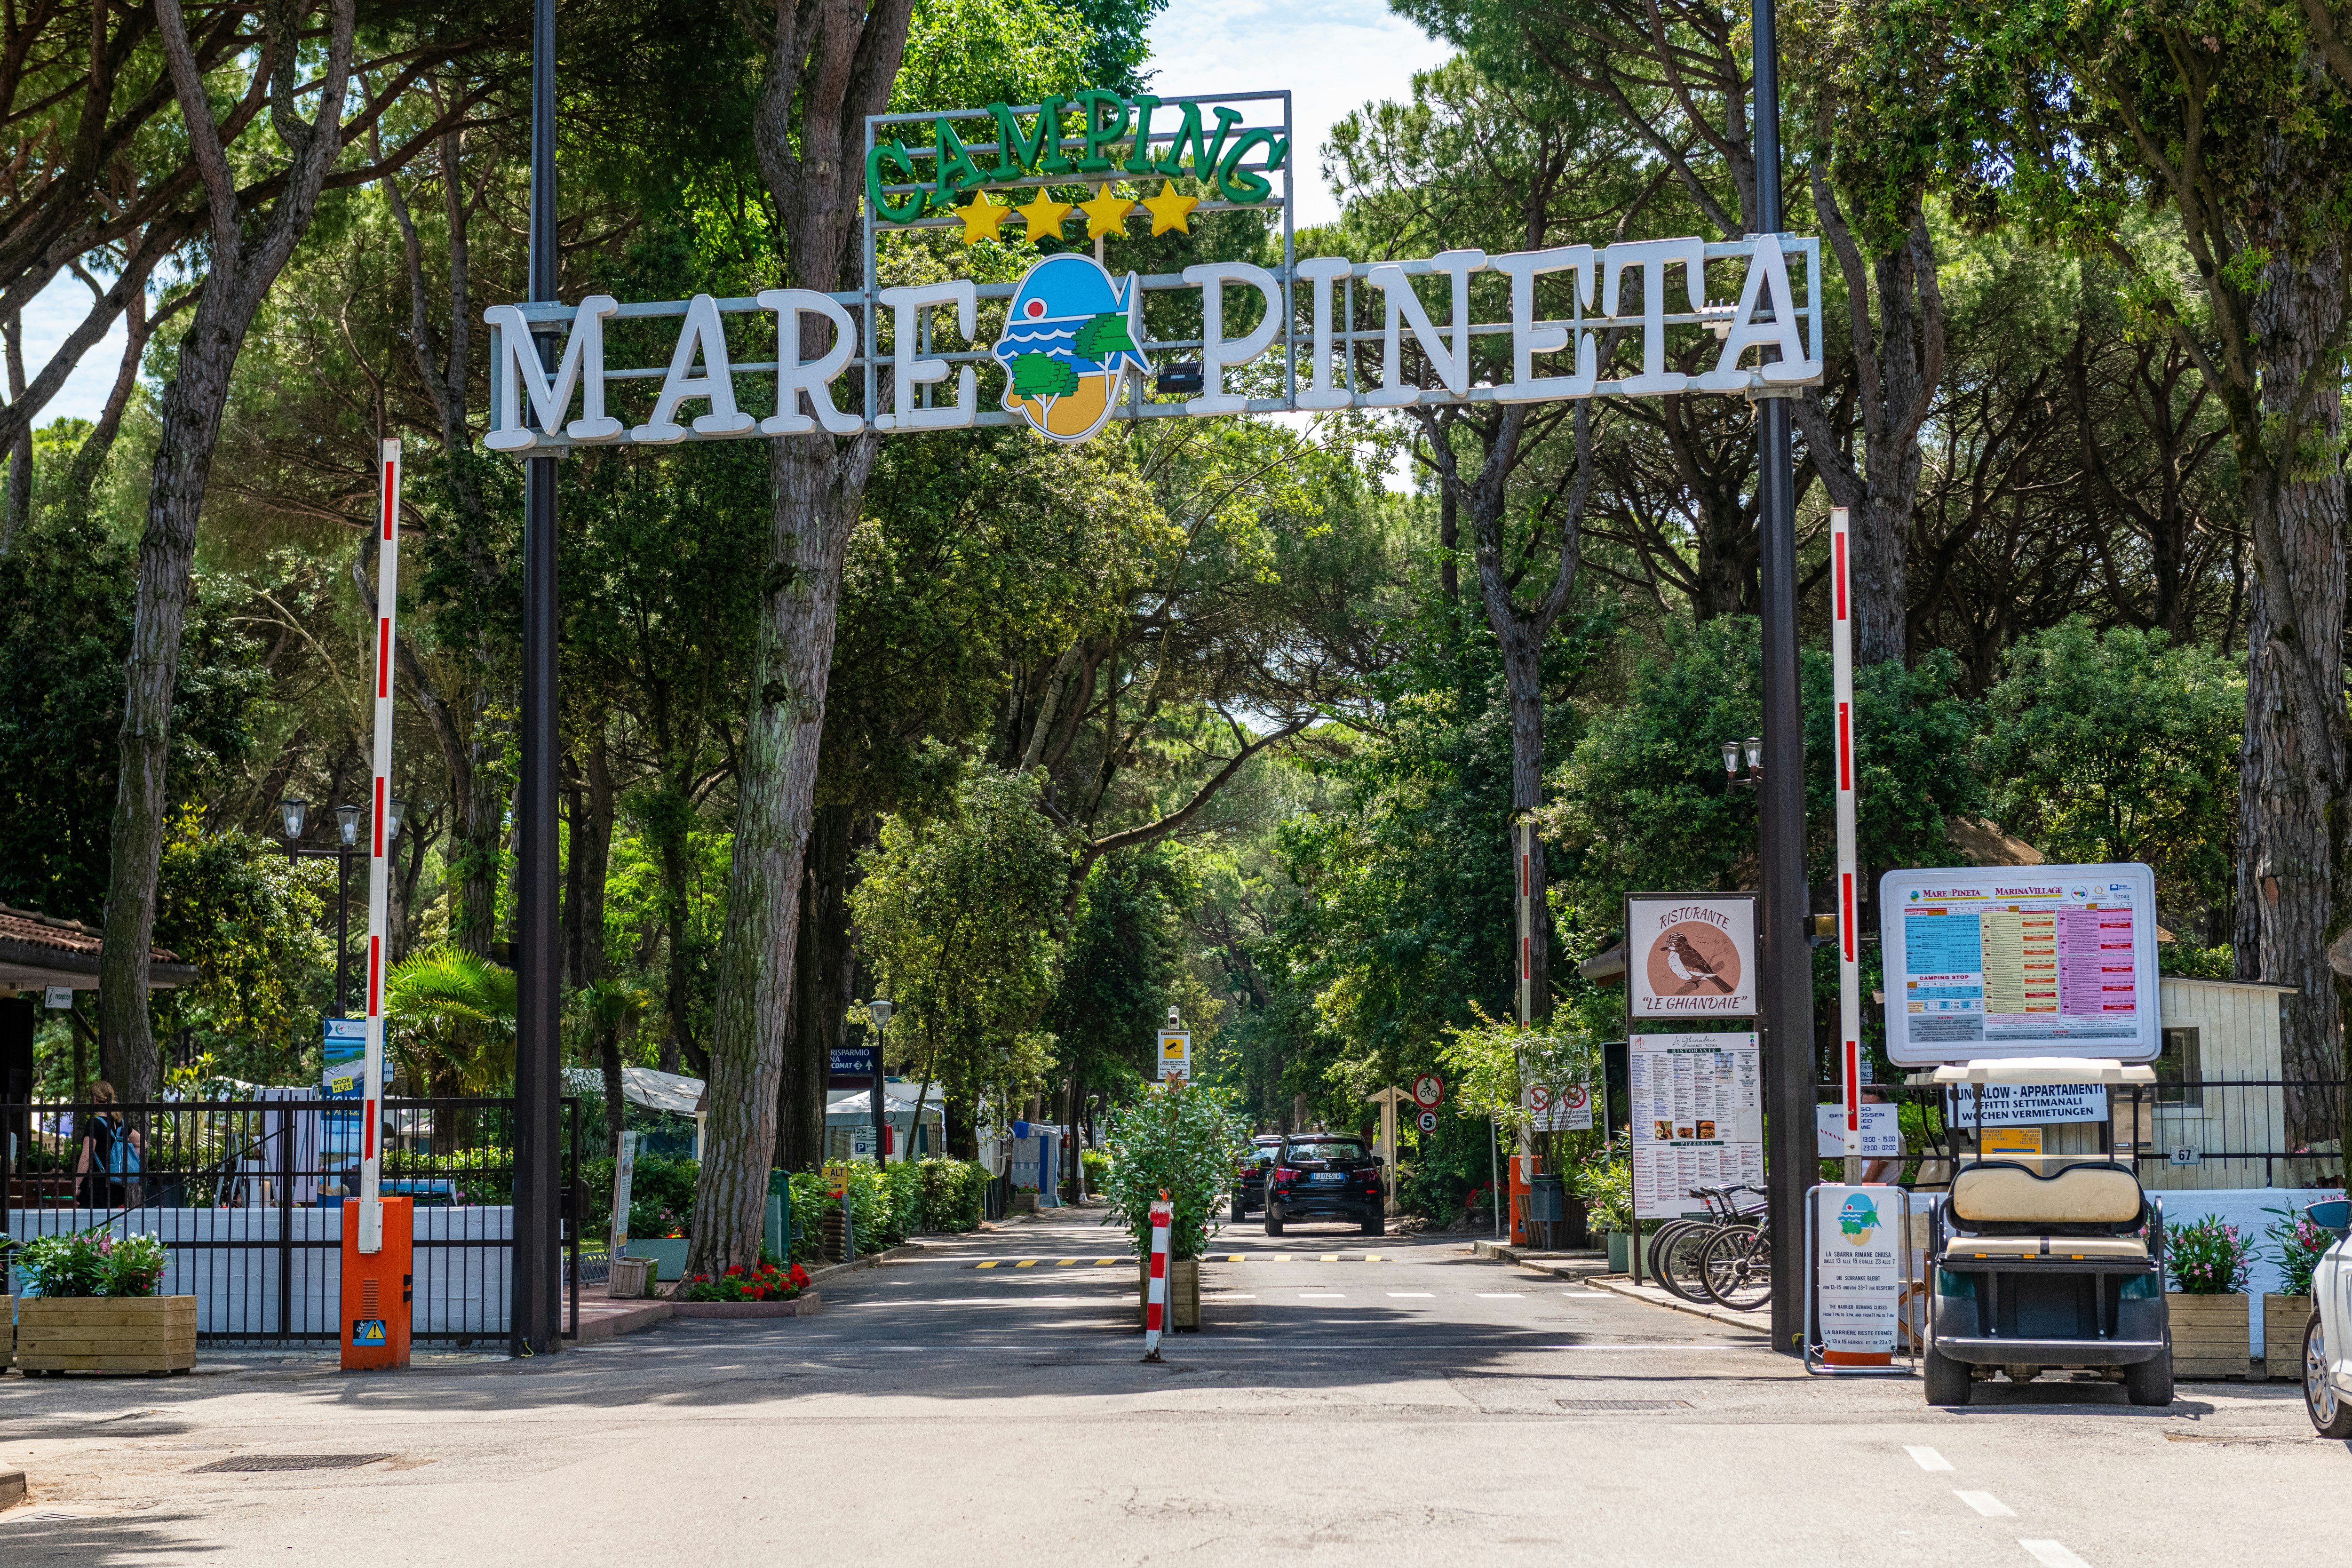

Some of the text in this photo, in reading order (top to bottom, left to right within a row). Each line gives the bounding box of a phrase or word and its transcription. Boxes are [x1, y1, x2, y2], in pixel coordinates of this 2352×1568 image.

[866, 88, 1289, 224] CAMPING
[484, 234, 1823, 451] MARE PINETA
[1660, 907, 1730, 930] RISTORANTE
[56, 993, 71, 1002] reception
[1672, 1035, 1716, 1047] Le Ghiandaie
[1959, 1083, 2103, 1100] UNALOW APPARTAMENTI
[2013, 1098, 2082, 1108] SETTIMANALI
[2012, 1107, 2093, 1118] VERMIETUNGEN
[1423, 1116, 1432, 1128] 5
[2178, 1149, 2191, 1160] 67
[357, 1320, 366, 1333] FAAC
